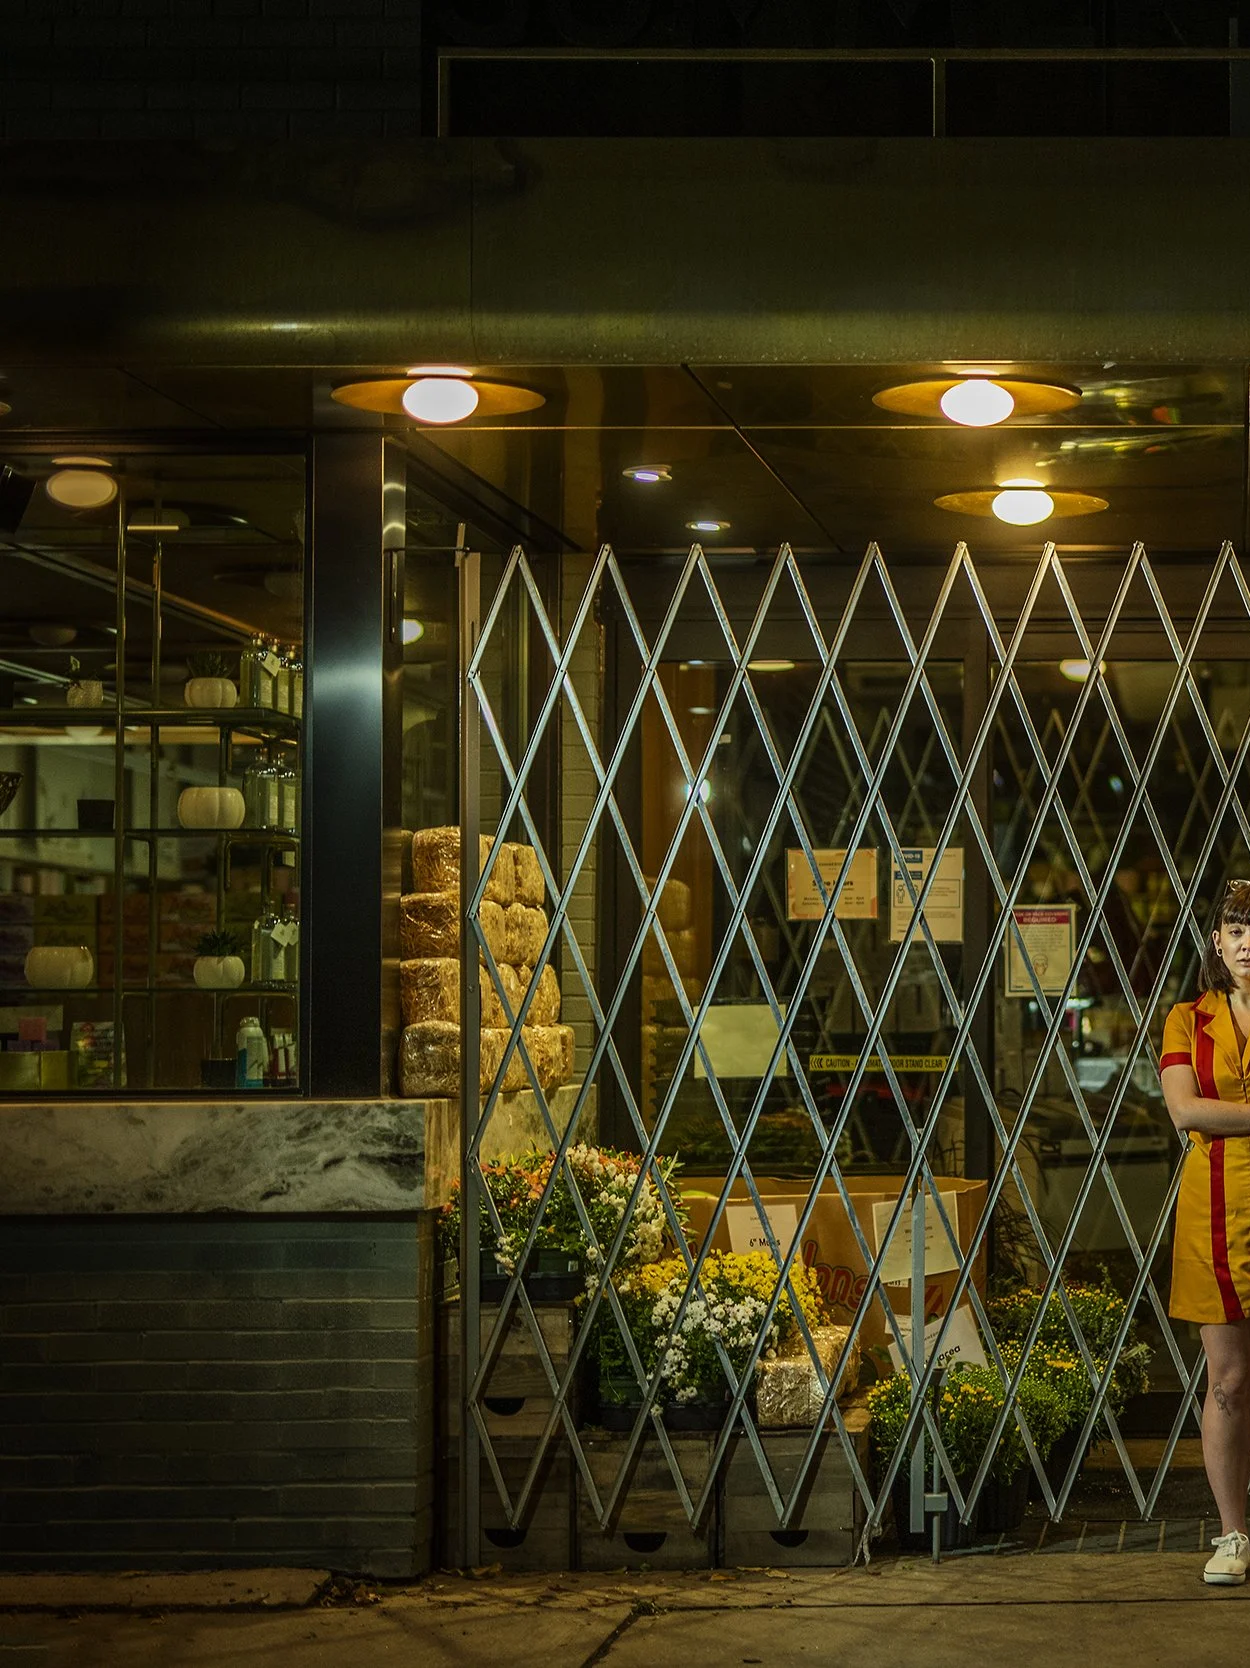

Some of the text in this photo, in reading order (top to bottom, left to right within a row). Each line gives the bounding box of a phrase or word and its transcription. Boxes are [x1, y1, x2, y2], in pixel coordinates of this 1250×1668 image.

[826, 1059, 850, 1068] CAUTION
[905, 1059, 923, 1068] STAND
[925, 1059, 943, 1068] CLEAR
[759, 1238, 781, 1247] Mus
